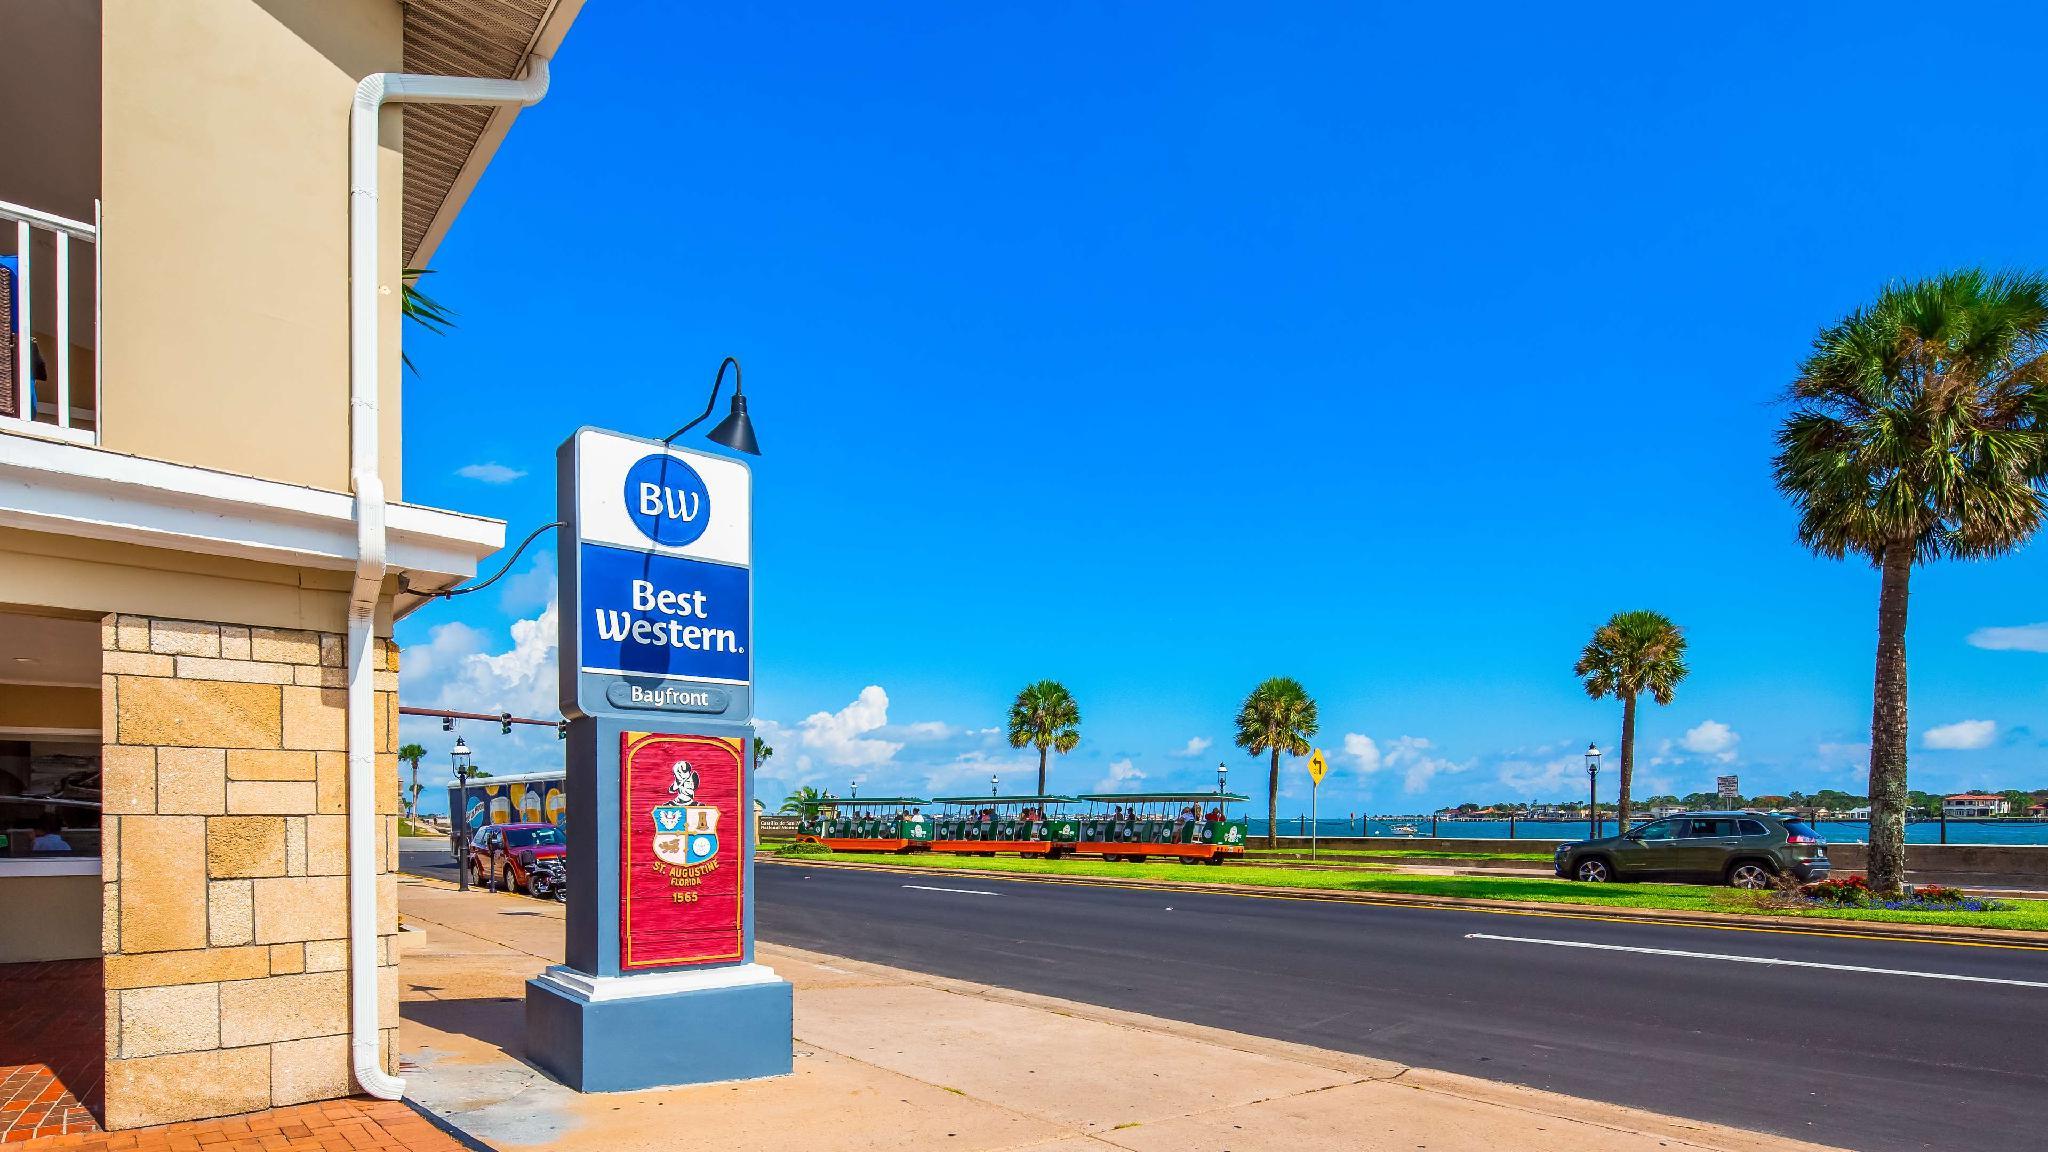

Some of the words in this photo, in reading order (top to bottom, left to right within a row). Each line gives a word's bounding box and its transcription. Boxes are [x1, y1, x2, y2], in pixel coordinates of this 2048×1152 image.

[640, 482, 699, 522] BW
[632, 579, 707, 619] Best
[631, 685, 709, 706] Bayfront
[653, 861, 666, 875] ST.
[669, 859, 719, 878] AUGUSTINE
[670, 877, 702, 887] FLORIDA
[672, 891, 698, 903] 1565
